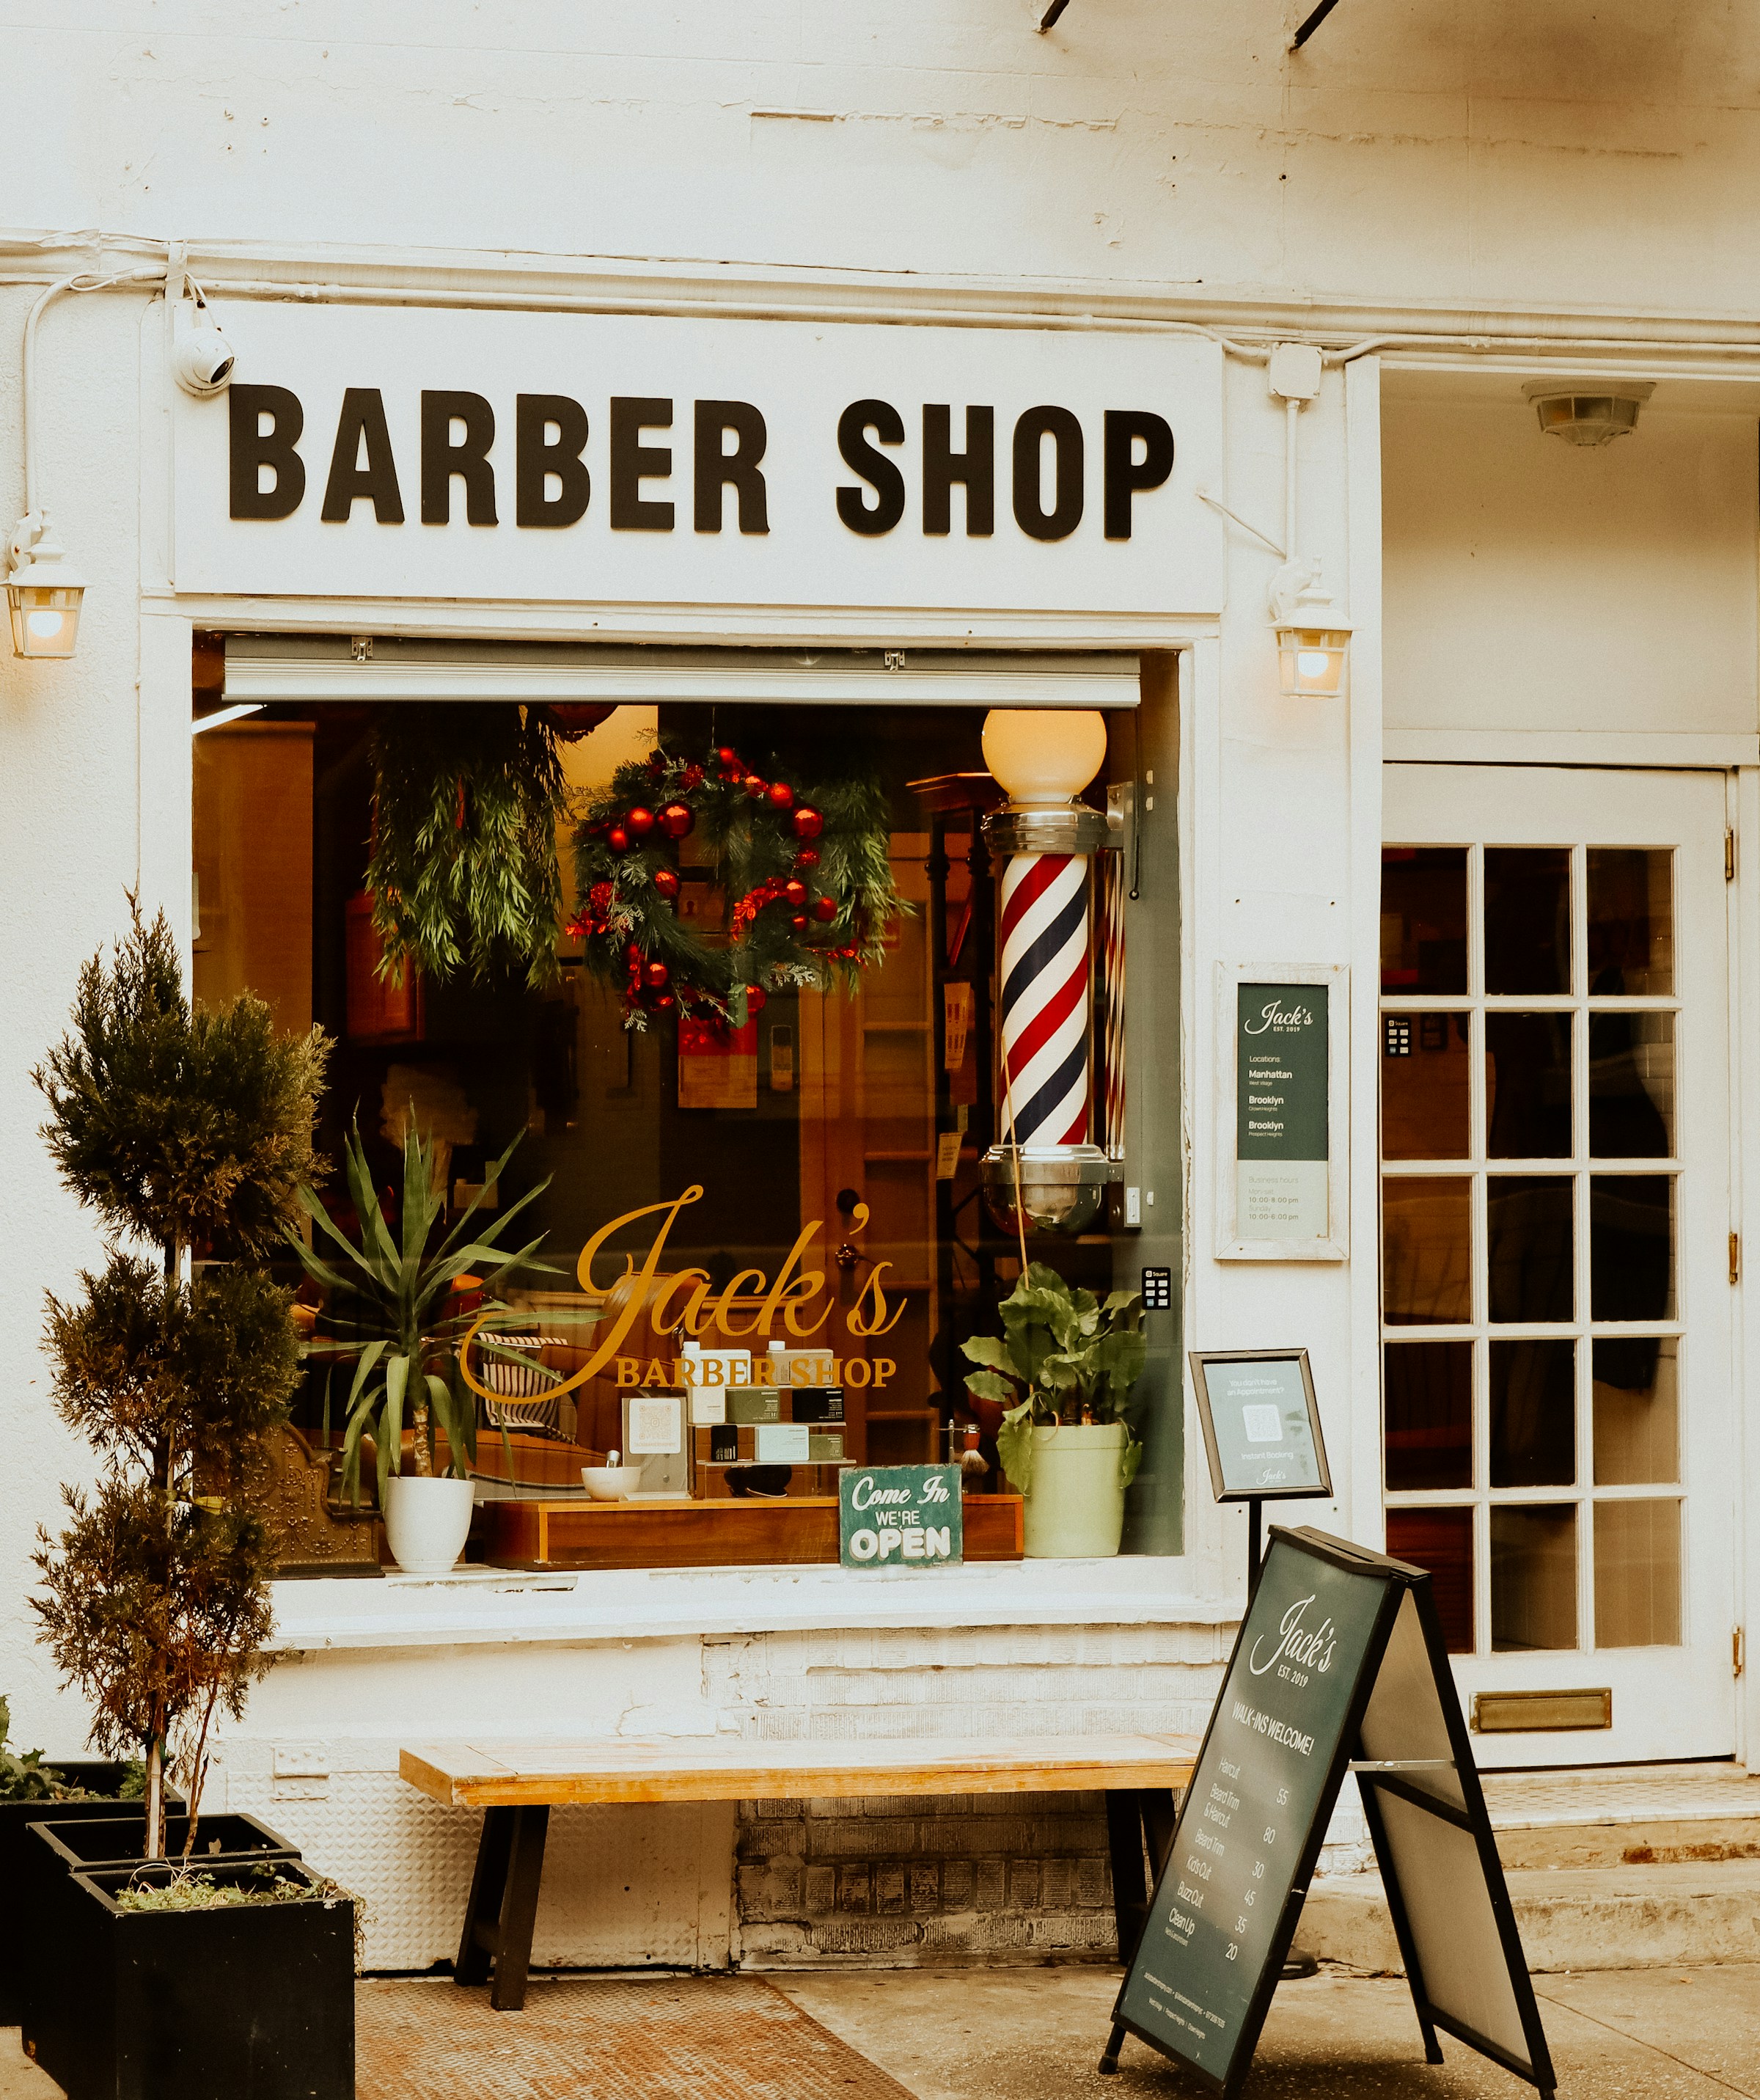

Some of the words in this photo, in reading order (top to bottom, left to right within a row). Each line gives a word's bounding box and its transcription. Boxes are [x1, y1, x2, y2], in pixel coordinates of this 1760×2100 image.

[229, 384, 770, 534] BARBER
[836, 398, 1174, 541] SHOP
[1244, 1000, 1313, 1035] Jack's
[1248, 1069, 1293, 1079] Manhattan
[1248, 1095, 1284, 1106] Brooklyn
[1248, 1121, 1284, 1131] Brooklyn
[460, 1185, 908, 1405] Jack's
[615, 1358, 778, 1389] BARBER
[791, 1358, 897, 1389] SHOP
[851, 1475, 911, 1511] Come
[916, 1475, 950, 1504] In
[1256, 1468, 1287, 1485] Jack's
[875, 1510, 921, 1526] WE'RE
[849, 1526, 951, 1562] OPEN
[1250, 1594, 1338, 1675] Jack's
[1277, 1664, 1291, 1680] EST.
[1292, 1670, 1309, 1688] 2019
[1231, 1700, 1270, 1734] WALK-INS
[1266, 1720, 1315, 1756] WELCOME!
[1209, 1783, 1228, 1804] Beard
[1227, 1790, 1240, 1810] Trim
[1219, 1757, 1241, 1779] Haircut
[1276, 1788, 1288, 1806] 55
[1211, 1806, 1231, 1829] Haircut
[1263, 1826, 1275, 1845] 80
[1195, 1829, 1213, 1851] Beard
[1211, 1837, 1225, 1857] Trim
[1252, 1861, 1264, 1879] 30
[1198, 1861, 1211, 1881] Cut
[1244, 1889, 1256, 1906] 45
[1177, 1881, 1192, 1902] Buzz
[1190, 1889, 1204, 1909] Cut
[1234, 1915, 1246, 1934] 35
[1169, 1907, 1187, 1929] Clean
[1184, 1917, 1196, 1936] Up
[1225, 1942, 1238, 1961] 20
